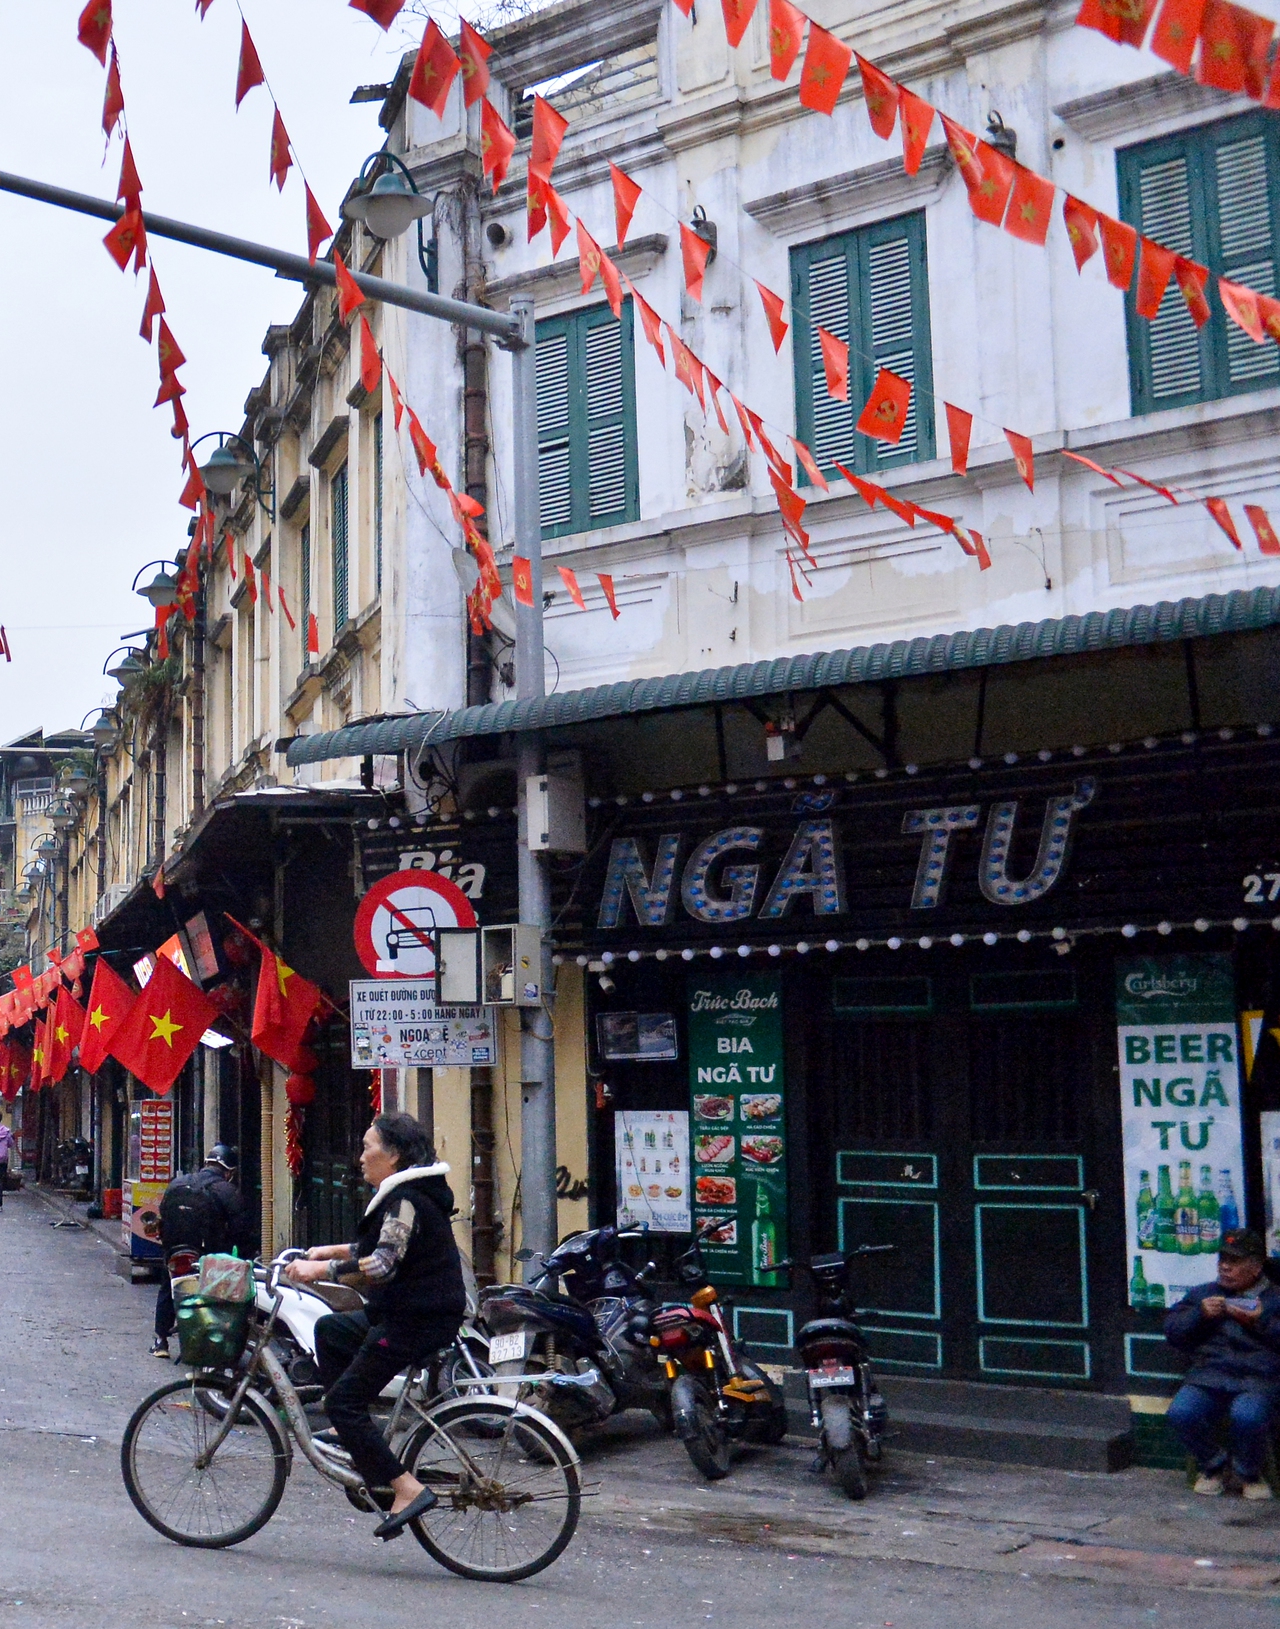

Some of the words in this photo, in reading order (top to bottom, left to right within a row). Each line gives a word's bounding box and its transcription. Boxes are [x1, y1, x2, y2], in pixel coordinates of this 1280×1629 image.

[597, 790, 848, 929] NGÃ
[901, 776, 1097, 909] TƯ
[1124, 972, 1197, 994] Carlsberg
[357, 991, 366, 1002] XE
[369, 988, 388, 1002] QUÉT
[391, 987, 417, 1001] ĐƯỜNG
[691, 990, 729, 1012] Trúc
[730, 989, 778, 1011] Bạch
[717, 1037, 754, 1053] BIA
[1125, 1033, 1233, 1065] BEER
[697, 1062, 742, 1083] NGÃ
[746, 1063, 776, 1083] TƯ
[1132, 1070, 1230, 1107] NGÃ
[1151, 1115, 1214, 1151] TƯ
[495, 1334, 520, 1349] 90-B2
[812, 1375, 850, 1385] ROLEX
